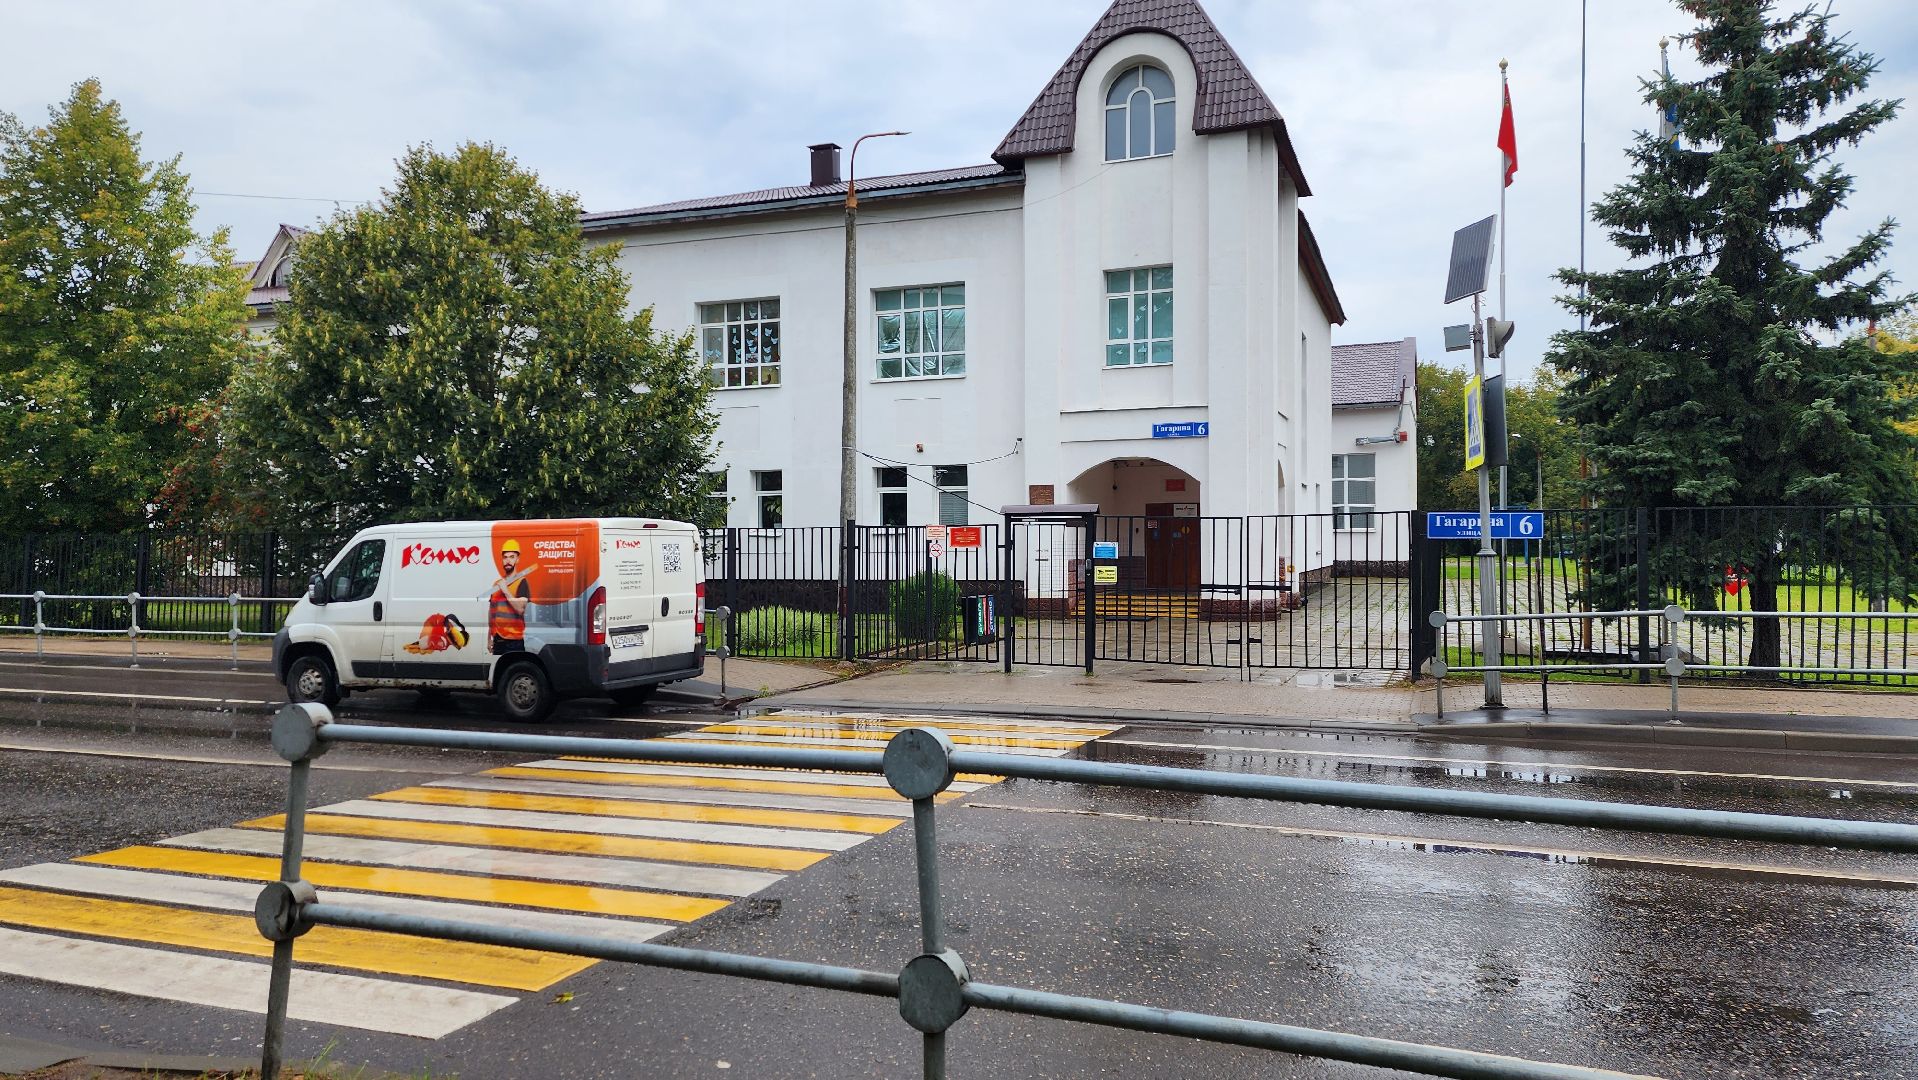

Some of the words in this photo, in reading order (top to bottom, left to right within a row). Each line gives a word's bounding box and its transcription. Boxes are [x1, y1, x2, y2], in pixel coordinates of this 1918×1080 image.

[1156, 425, 1191, 433] Гагарина
[1198, 424, 1205, 435] 6
[1520, 515, 1533, 534] 6
[533, 540, 576, 550] СРЕДСТВА
[402, 543, 480, 568] Комус
[538, 550, 575, 559] ЗАЩИТЫ
